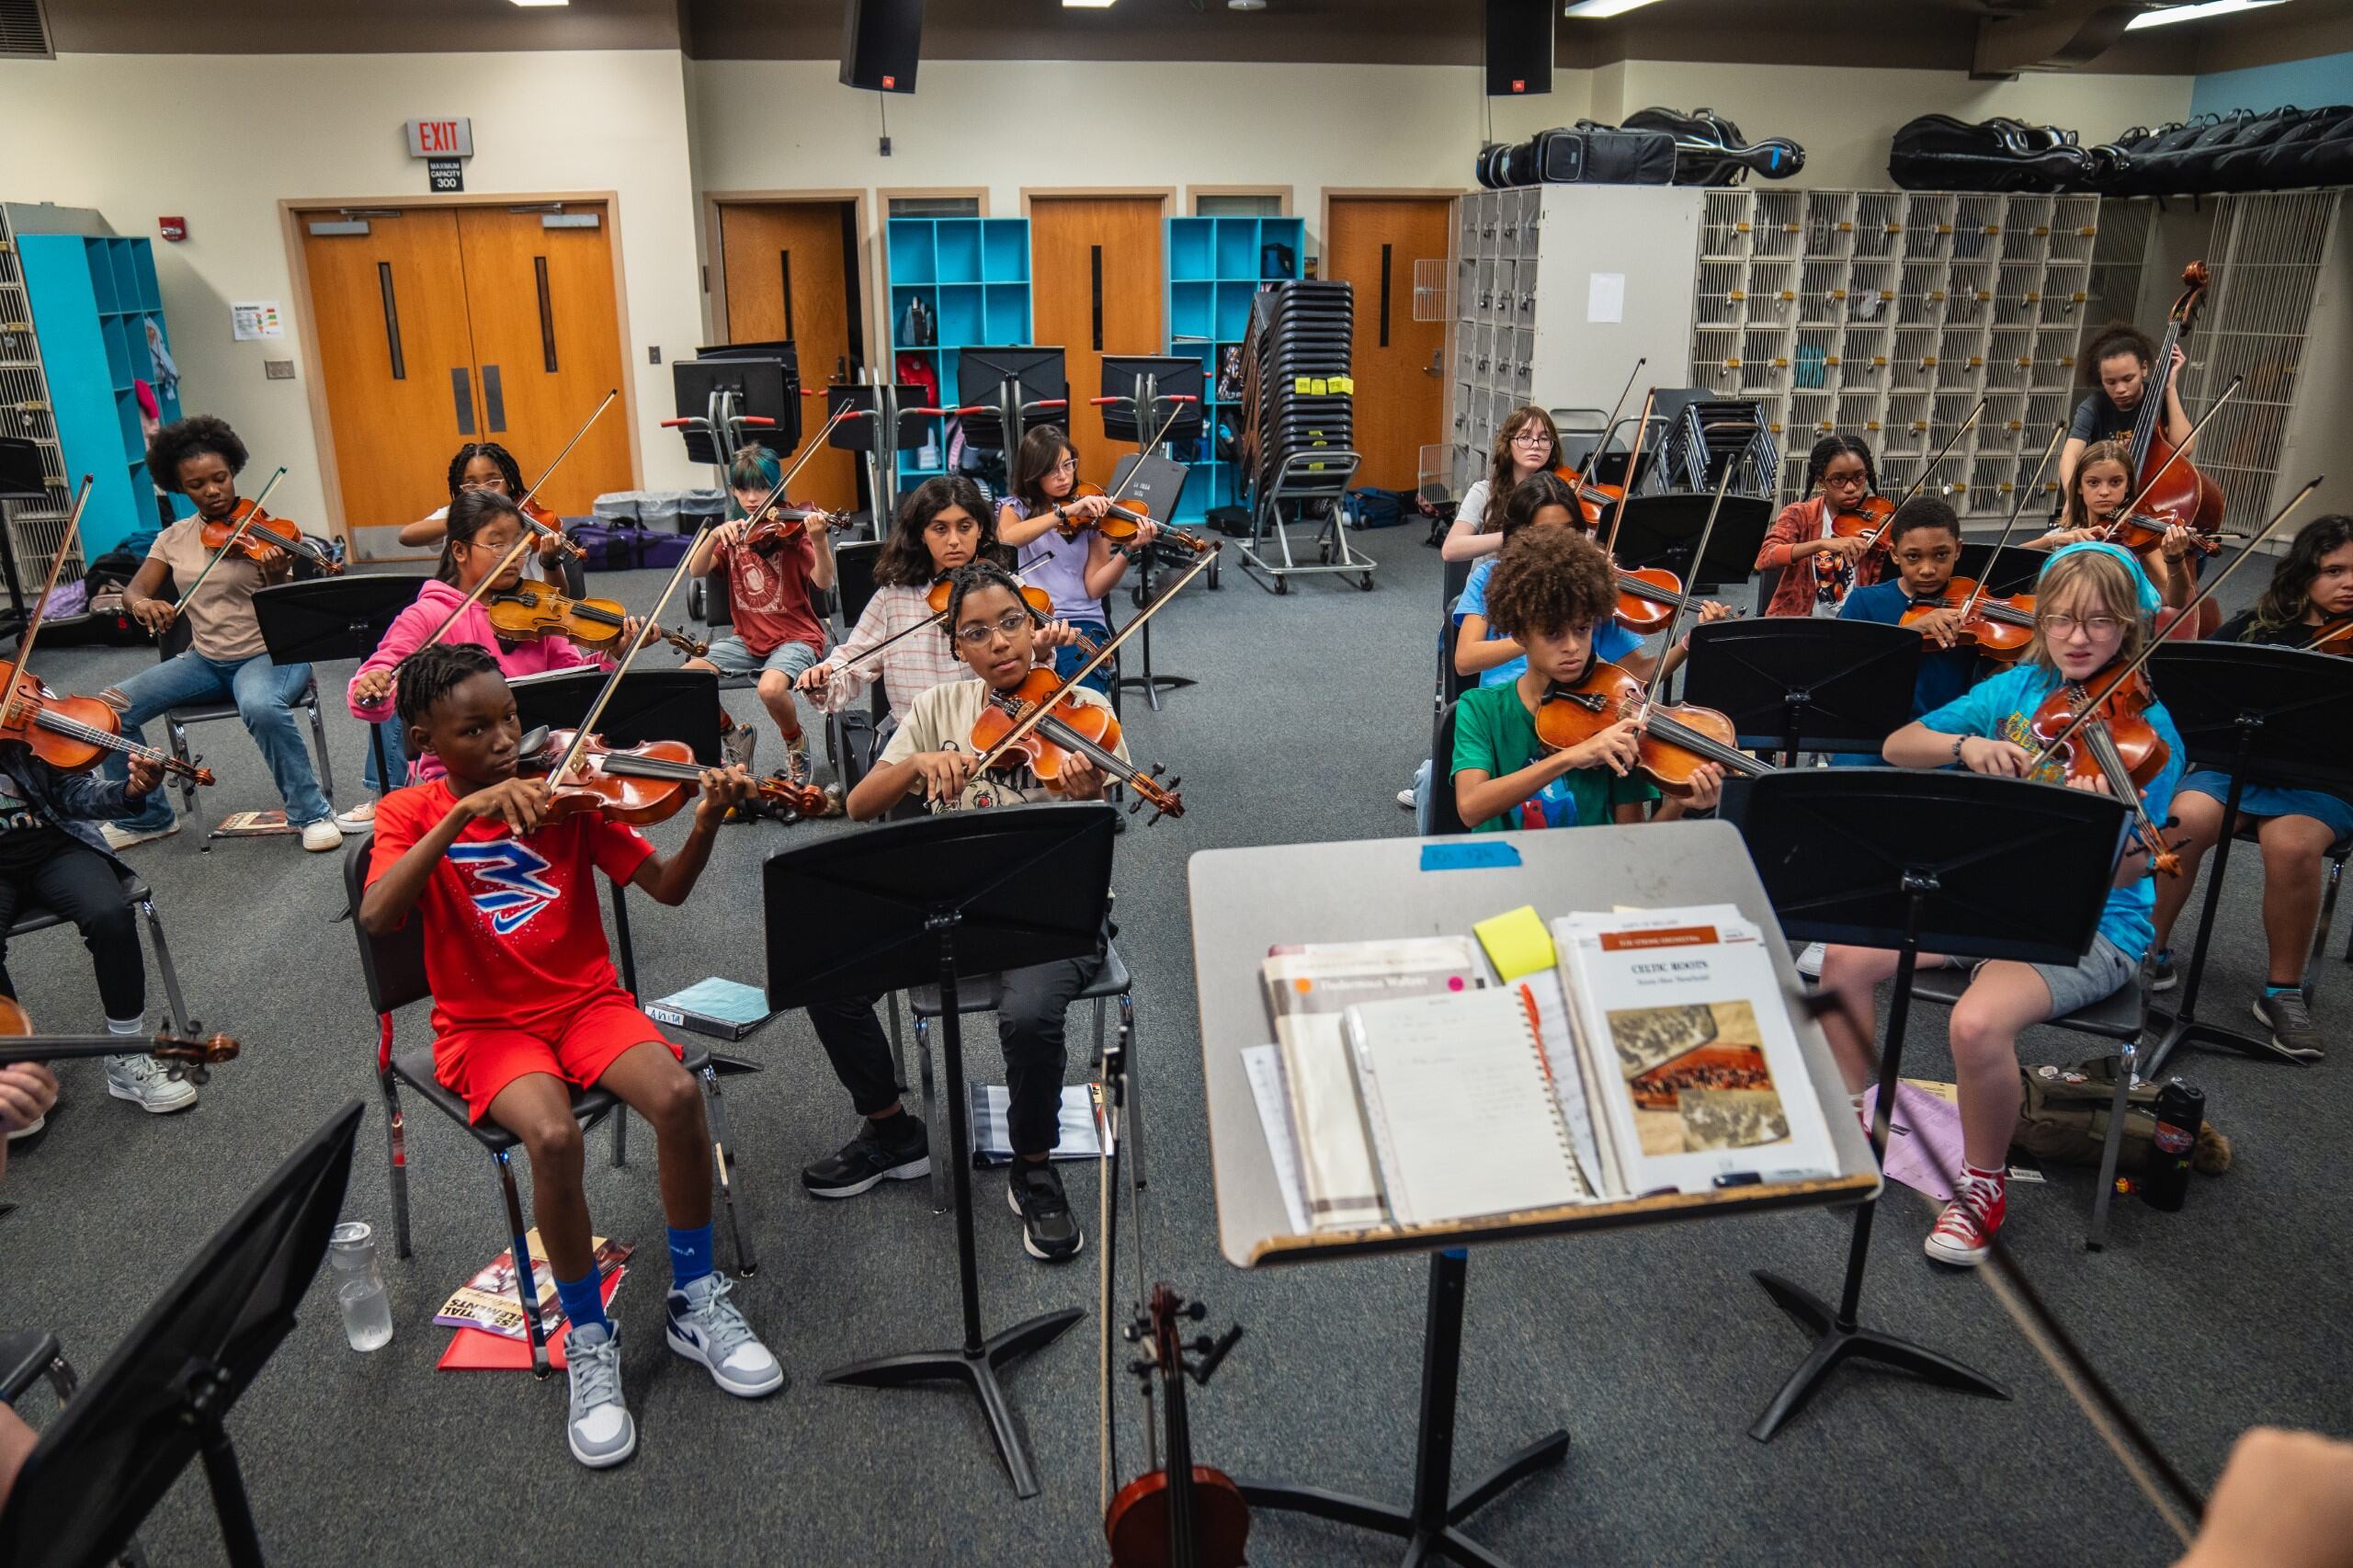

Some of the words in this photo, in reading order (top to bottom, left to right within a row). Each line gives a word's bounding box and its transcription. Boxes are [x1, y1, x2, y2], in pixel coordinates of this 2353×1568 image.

[418, 121, 457, 152] EXIT
[437, 178, 457, 187] 300
[1631, 962, 1667, 974] CELTIC
[1670, 960, 1709, 971] ROOTS
[651, 1008, 680, 1024] Anita
[443, 1306, 519, 1329] ESSTIAL
